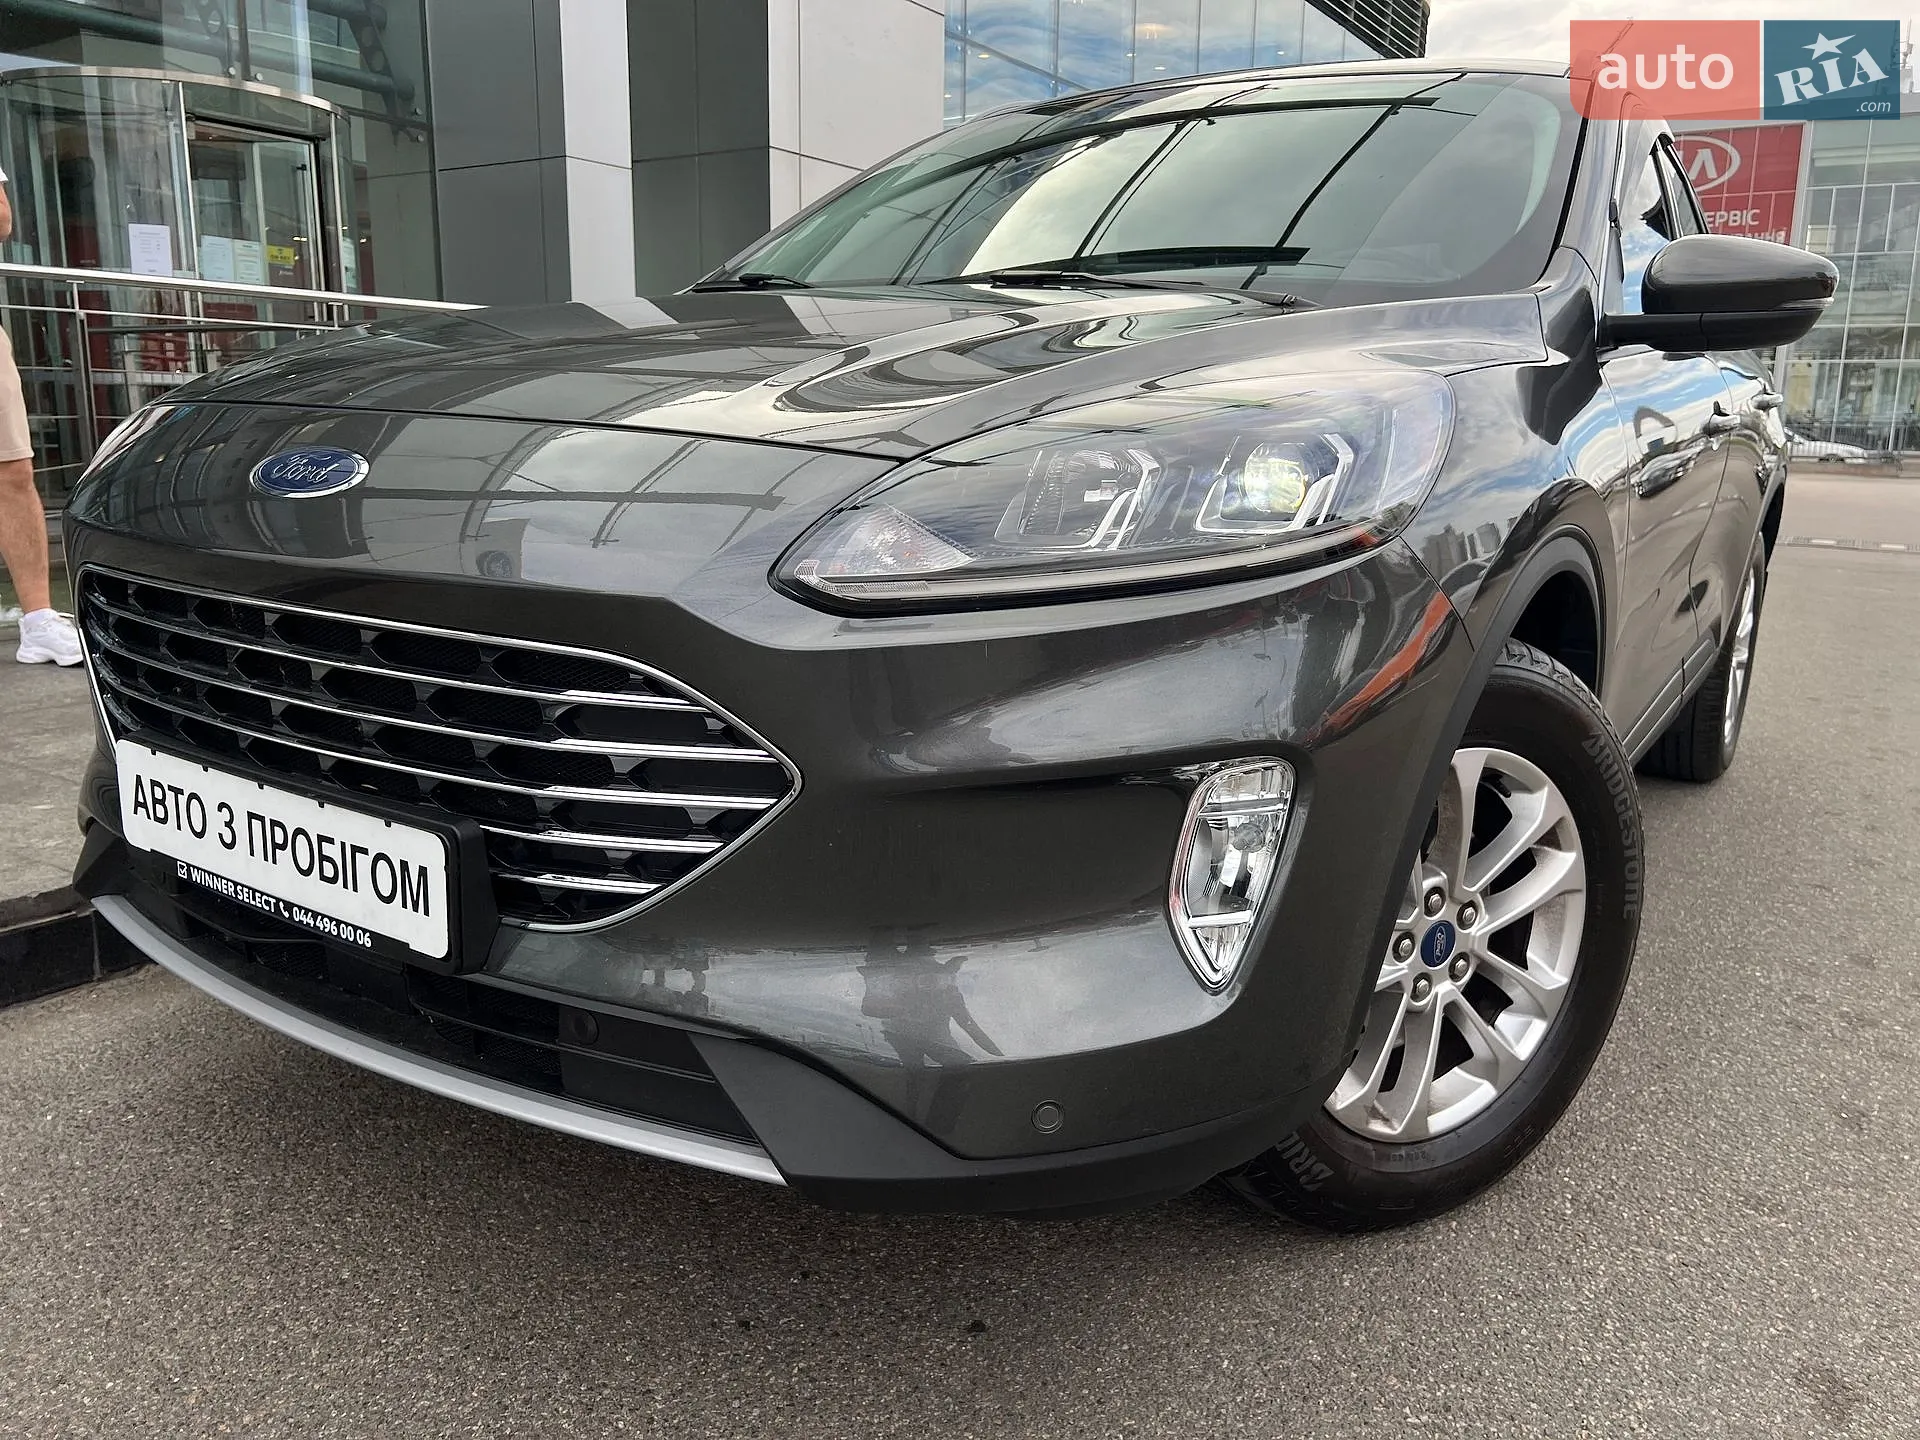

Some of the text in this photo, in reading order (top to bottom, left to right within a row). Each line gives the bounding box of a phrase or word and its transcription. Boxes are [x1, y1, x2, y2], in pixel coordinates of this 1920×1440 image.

[1702, 208, 1761, 228] ЕРВІС
[270, 453, 340, 484] Ford
[133, 774, 208, 840] АВТО
[246, 811, 432, 918] ПРОБІГОМ
[190, 866, 372, 948] WINNER SELECT 044 496 00 06
